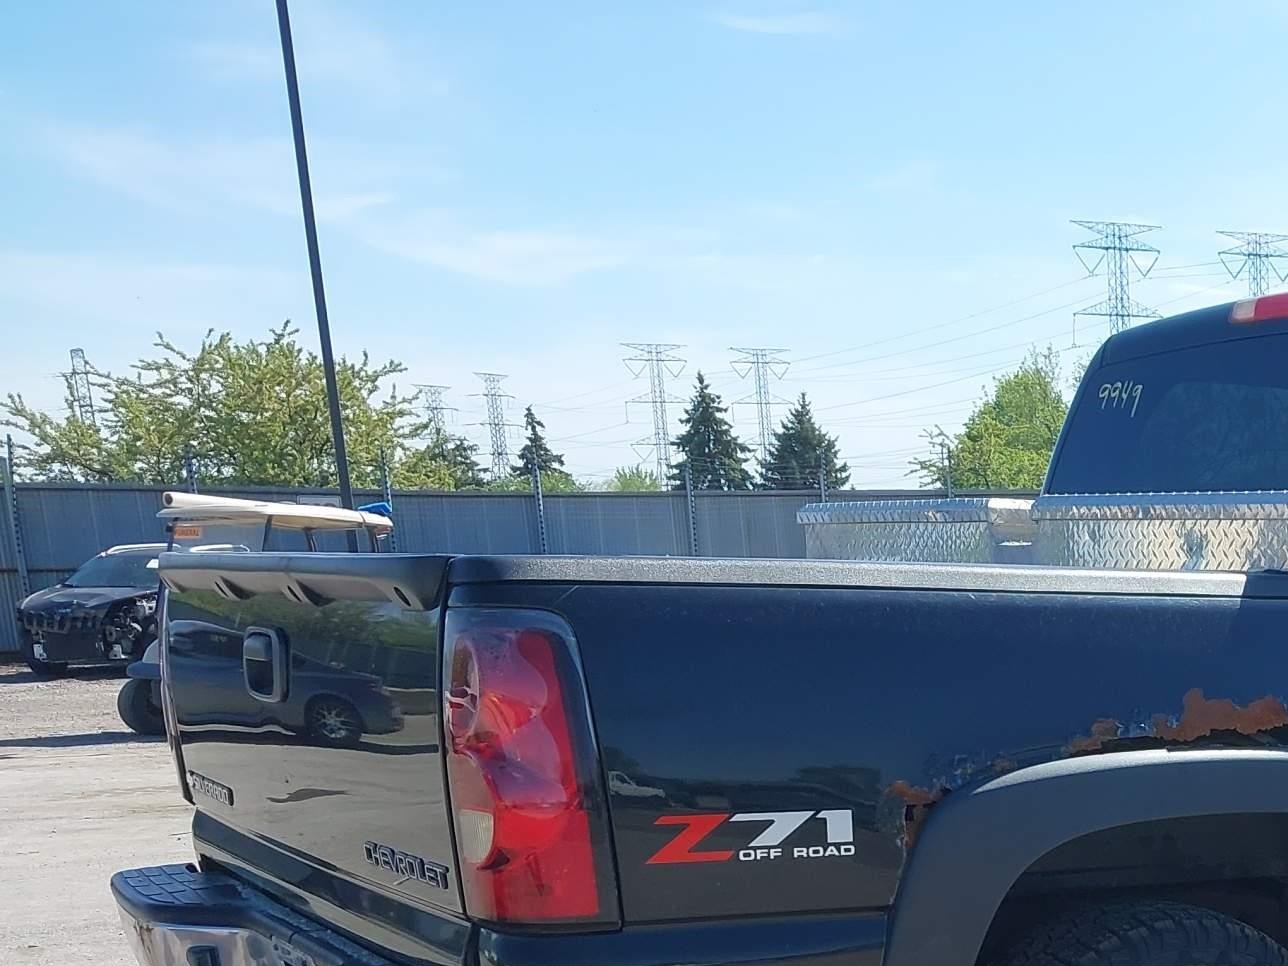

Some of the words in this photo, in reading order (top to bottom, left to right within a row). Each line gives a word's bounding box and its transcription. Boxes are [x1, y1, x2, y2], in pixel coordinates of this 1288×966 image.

[1099, 380, 1143, 418] 9949
[645, 809, 854, 864] Z71
[738, 848, 783, 861] OFF
[793, 845, 856, 858] ROAD
[363, 841, 449, 889] CHEVROLET
